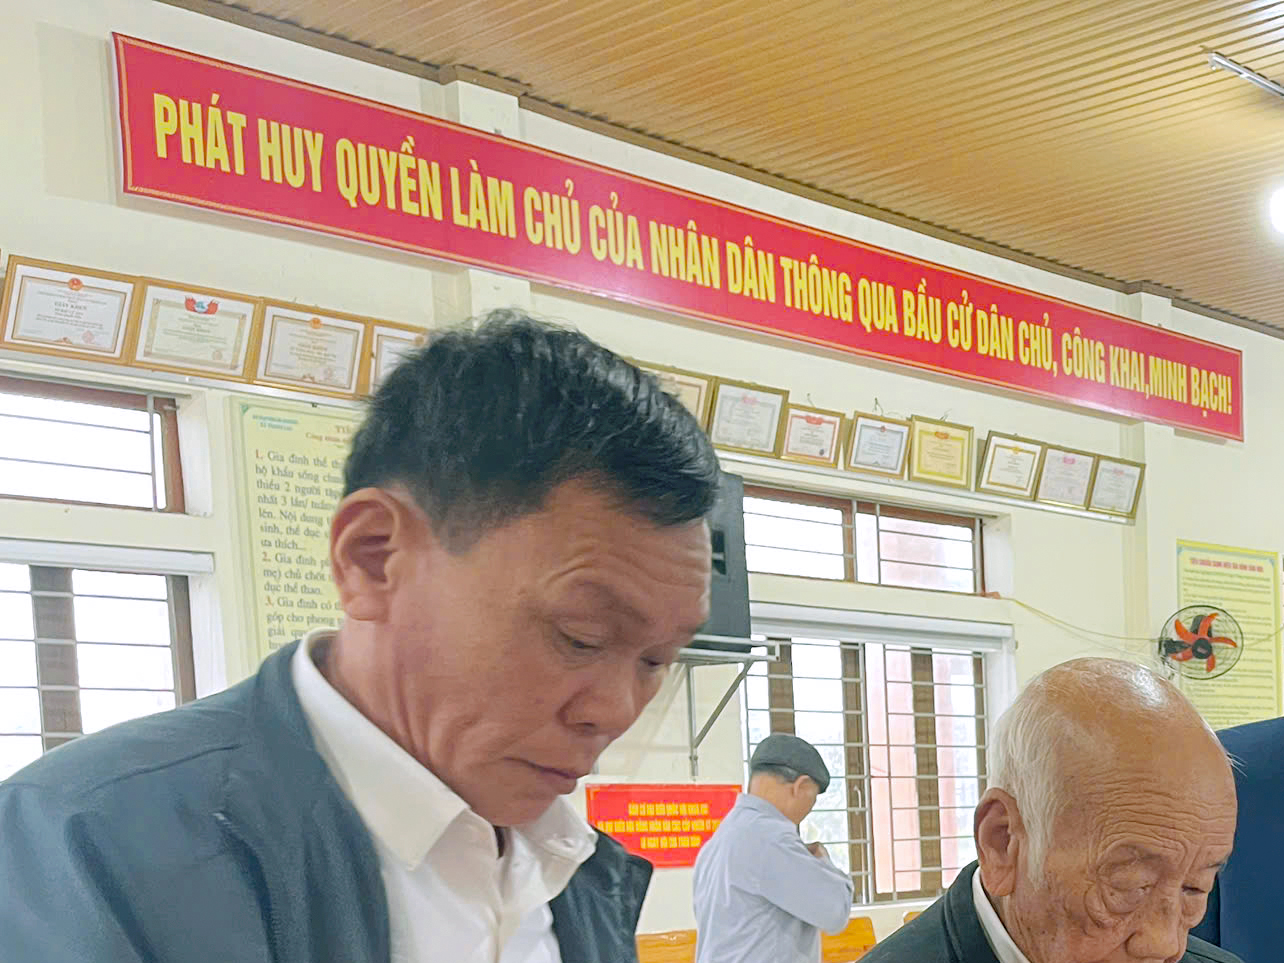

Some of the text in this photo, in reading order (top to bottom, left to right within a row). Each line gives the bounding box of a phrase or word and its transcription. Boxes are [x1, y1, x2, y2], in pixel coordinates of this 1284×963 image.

[153, 92, 247, 176] PHÁT
[257, 117, 324, 193] HUY
[336, 136, 443, 222] QUYỀN
[450, 159, 516, 239] LÀM
[524, 178, 581, 255] CHỦ
[589, 192, 644, 270] CỦA
[649, 220, 721, 290] NHÂN
[726, 235, 776, 304] DÂN
[780, 254, 853, 323] THÔNG
[858, 277, 898, 335] QUA
[902, 277, 942, 344] BẦU
[947, 289, 975, 351] CỬ
[976, 300, 1014, 361] DÂN
[1018, 312, 1059, 376] CHỦ,
[1061, 326, 1105, 383] CÔNG
[1191, 365, 1233, 418] BẠCH!
